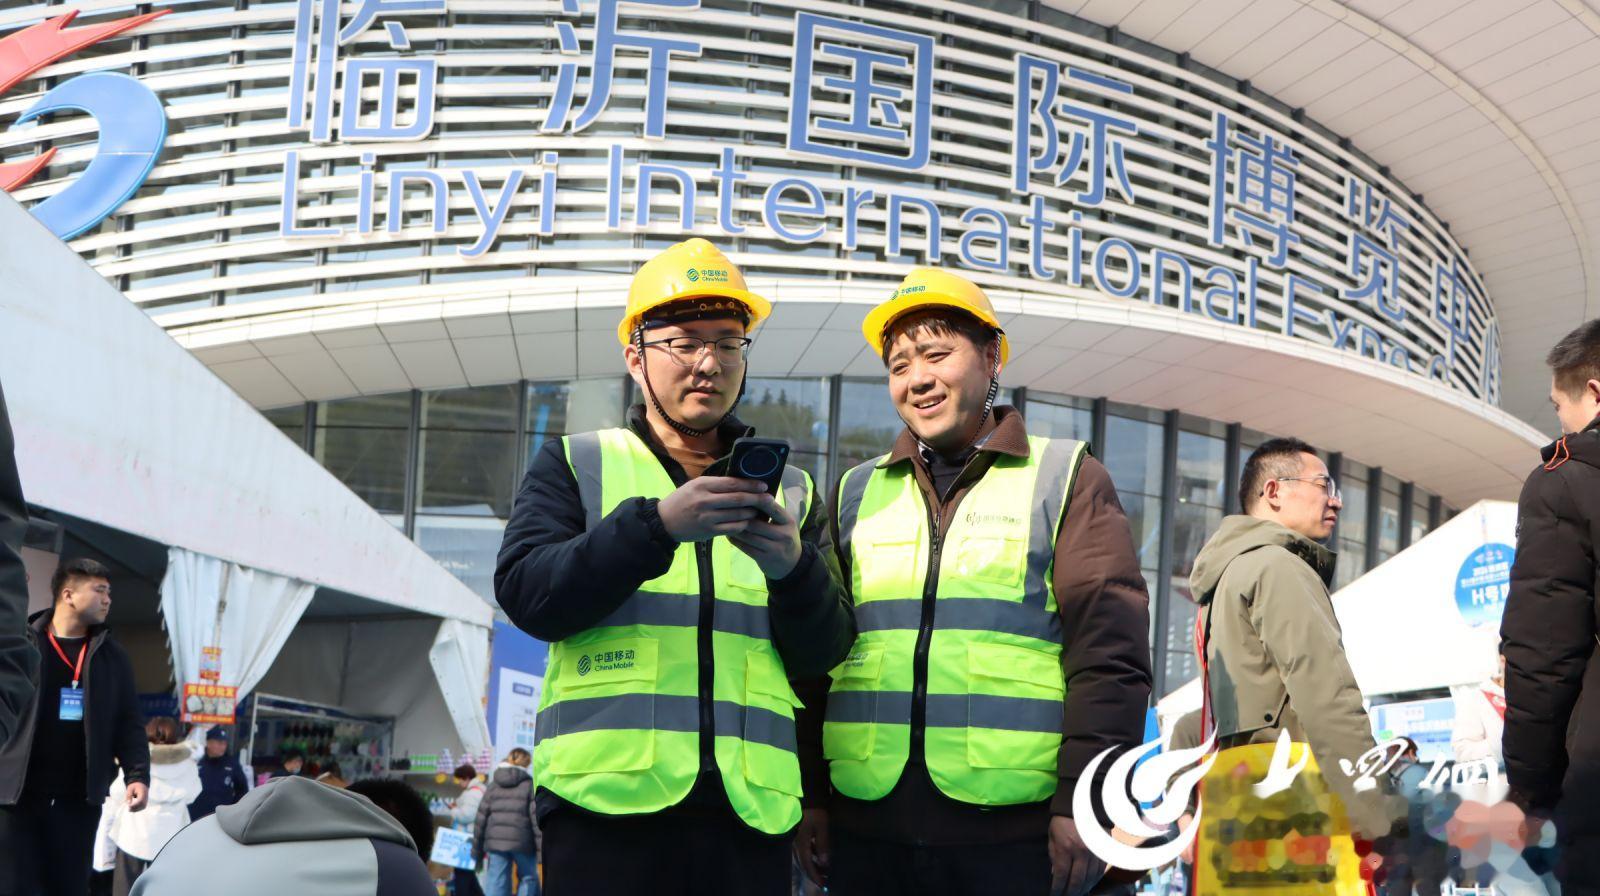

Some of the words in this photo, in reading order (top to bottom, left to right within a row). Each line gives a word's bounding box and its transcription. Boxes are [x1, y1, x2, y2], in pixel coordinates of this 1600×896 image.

[280, 150, 559, 260] Linyi
[607, 144, 1258, 329] International
[594, 649, 635, 662] 中国移动
